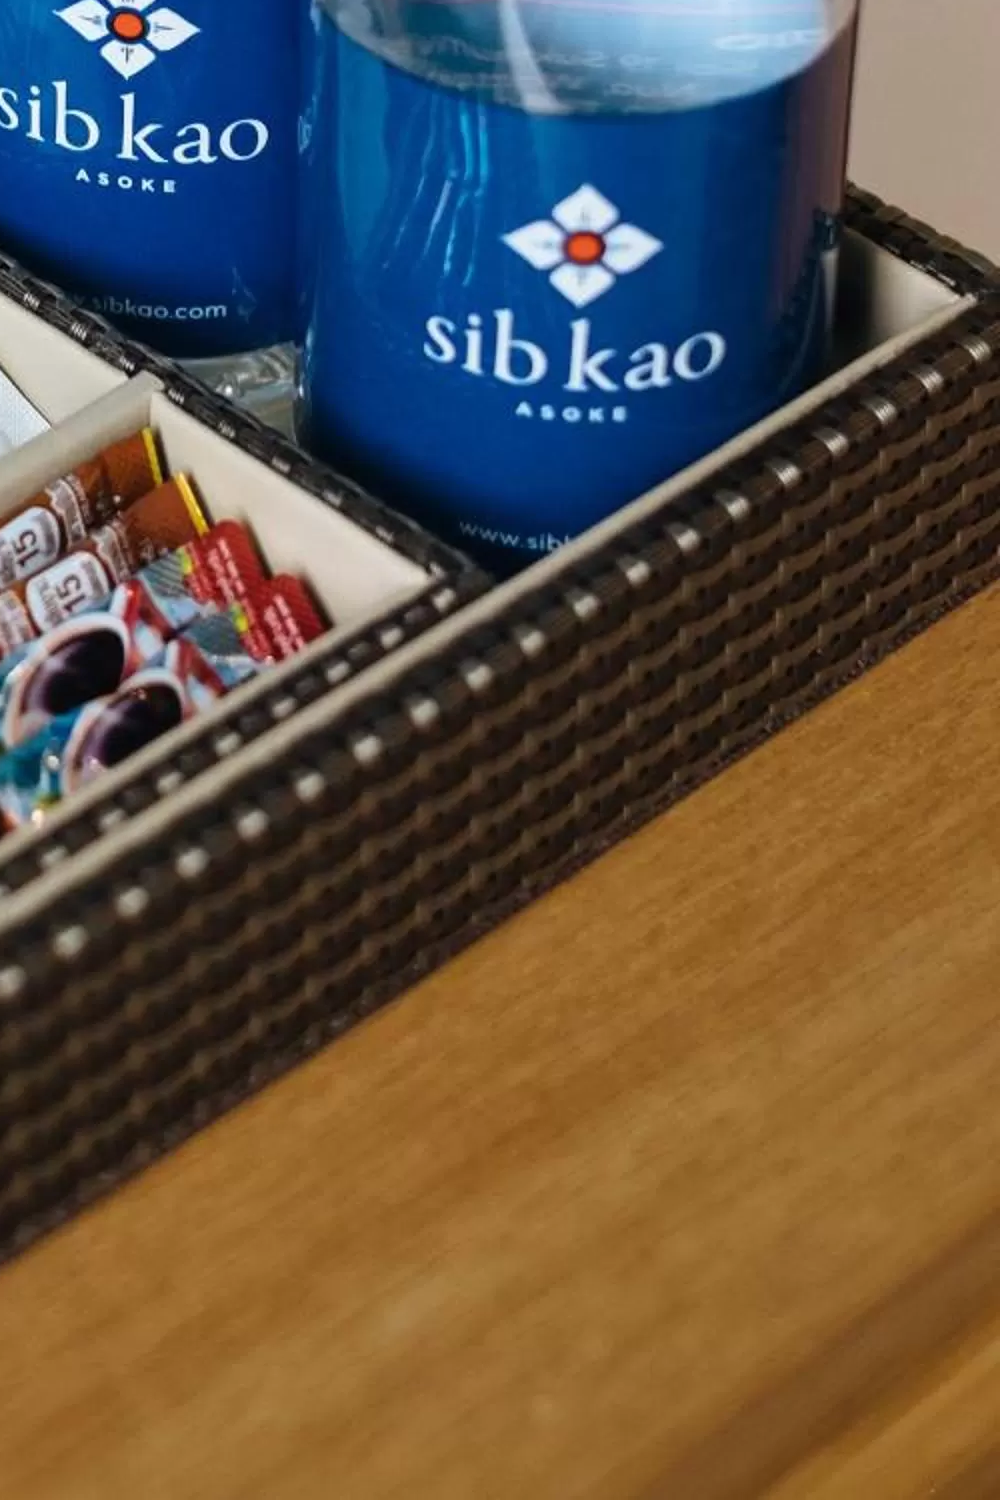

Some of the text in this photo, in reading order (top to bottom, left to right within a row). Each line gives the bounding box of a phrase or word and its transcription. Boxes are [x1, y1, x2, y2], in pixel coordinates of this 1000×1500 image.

[116, 92, 269, 165] kao
[76, 168, 177, 194] ASOKE
[423, 308, 727, 392] sib kao
[515, 401, 628, 423] ASOKE
[12, 529, 40, 567] 15
[459, 520, 570, 552] www.sib
[56, 574, 86, 613] 15
